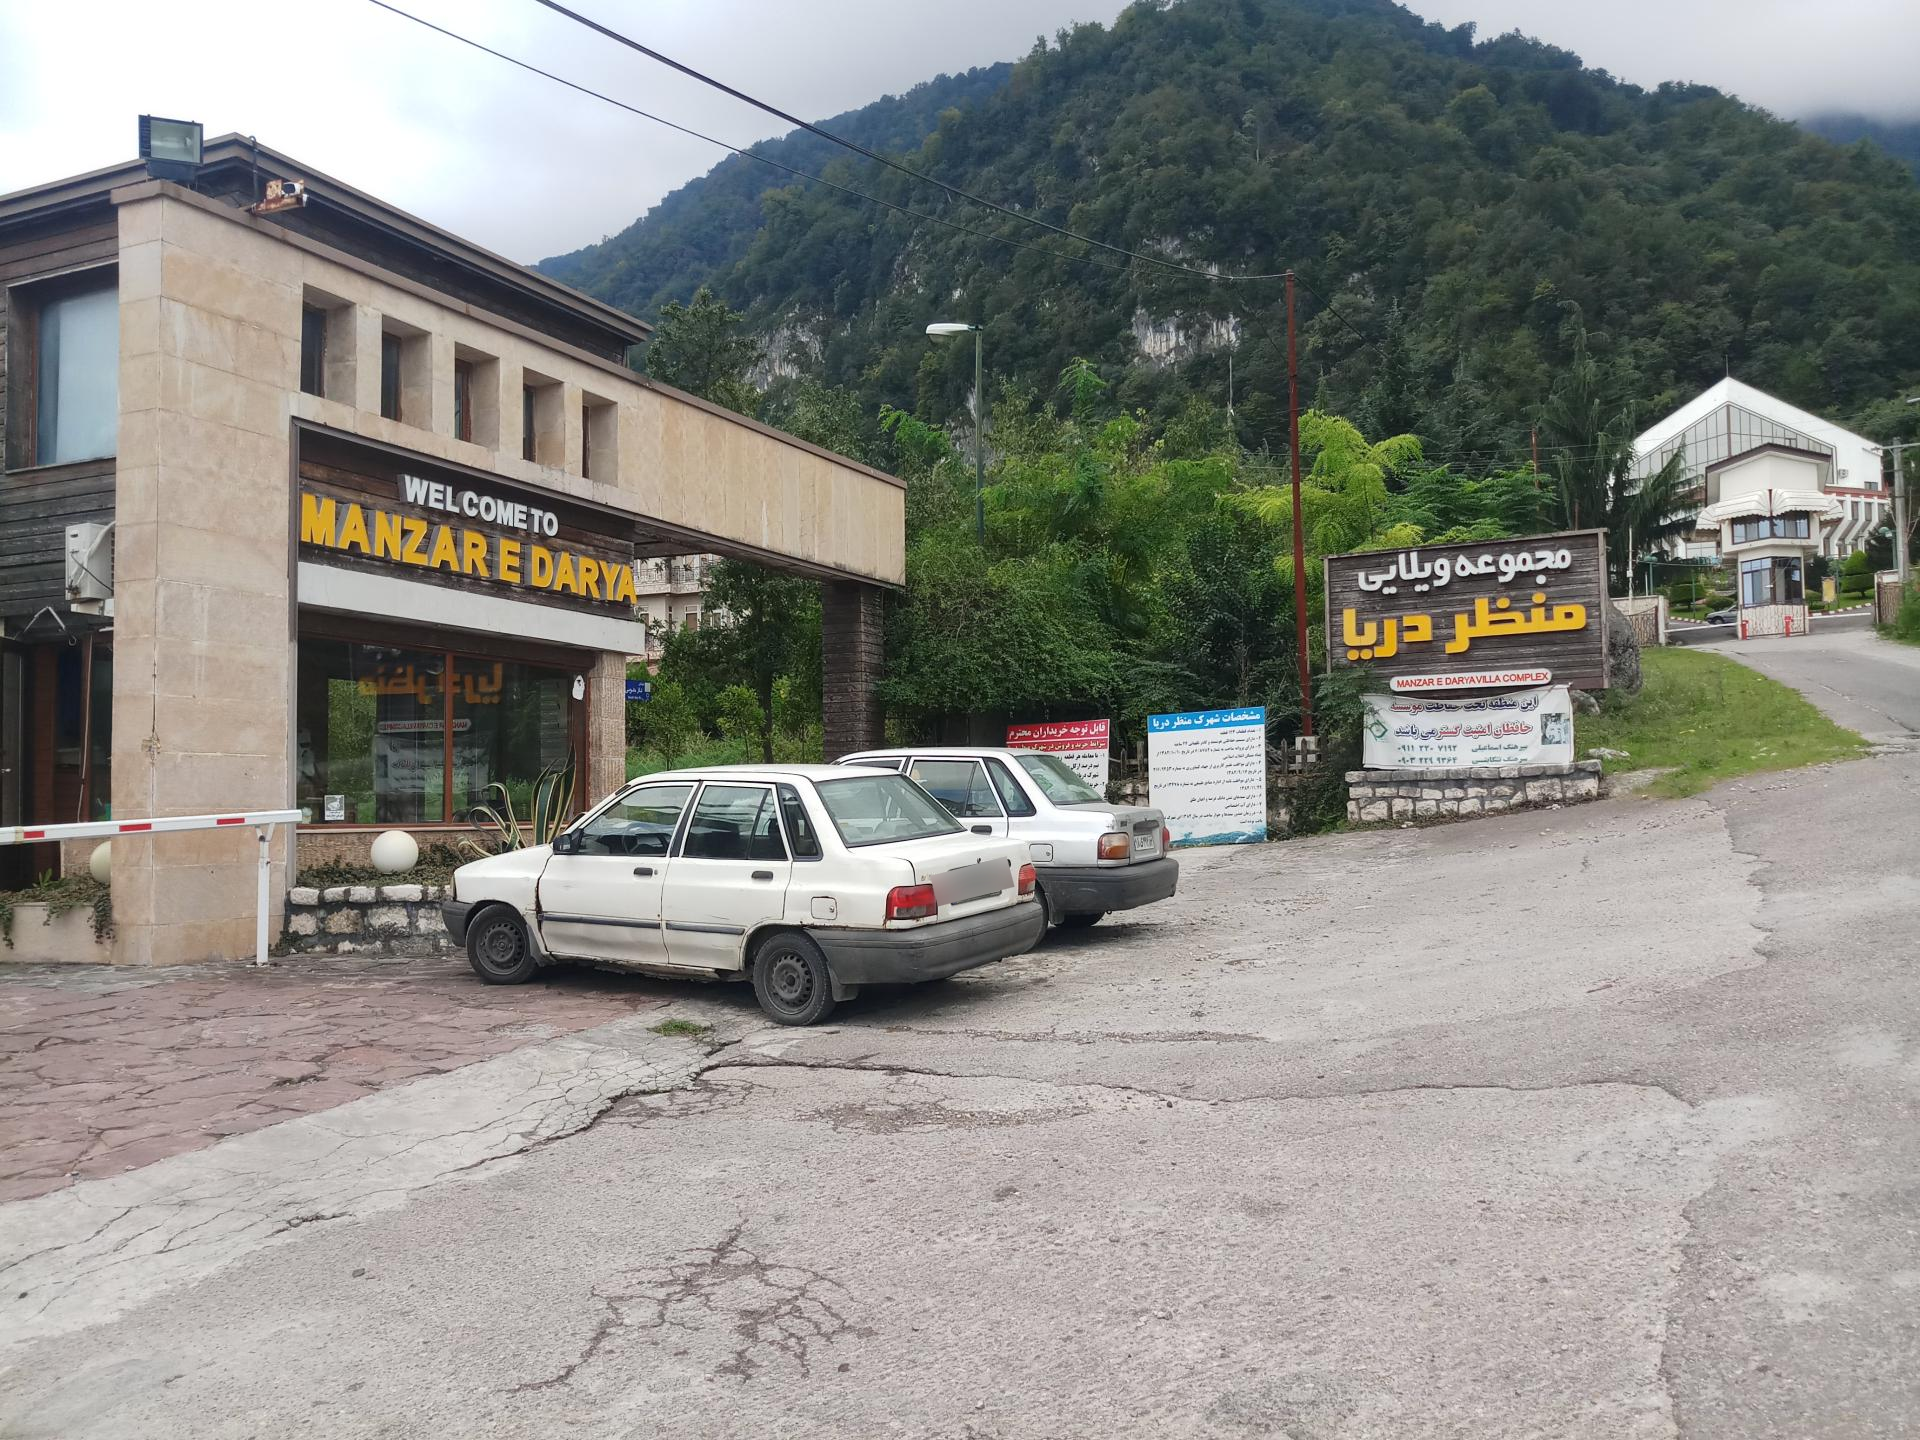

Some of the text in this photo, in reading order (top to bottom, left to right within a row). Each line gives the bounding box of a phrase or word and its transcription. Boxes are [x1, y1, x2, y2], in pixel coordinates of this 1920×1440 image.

[403, 474, 559, 536] WELCOME TO
[301, 493, 637, 604] MANZAR E DARYA
[1358, 549, 1572, 594] مجموعه ویلایی
[1342, 592, 1587, 661] منظر دریا
[1396, 672, 1549, 688] MANZAR E DARYA VILLA COMPLEX
[1488, 697, 1519, 711] منطقه
[1153, 710, 1261, 730] مشخصات شهرک منظر دریا
[1493, 720, 1533, 739] حافظان
[1009, 722, 1106, 740] قابل توجه خریداران محترم
